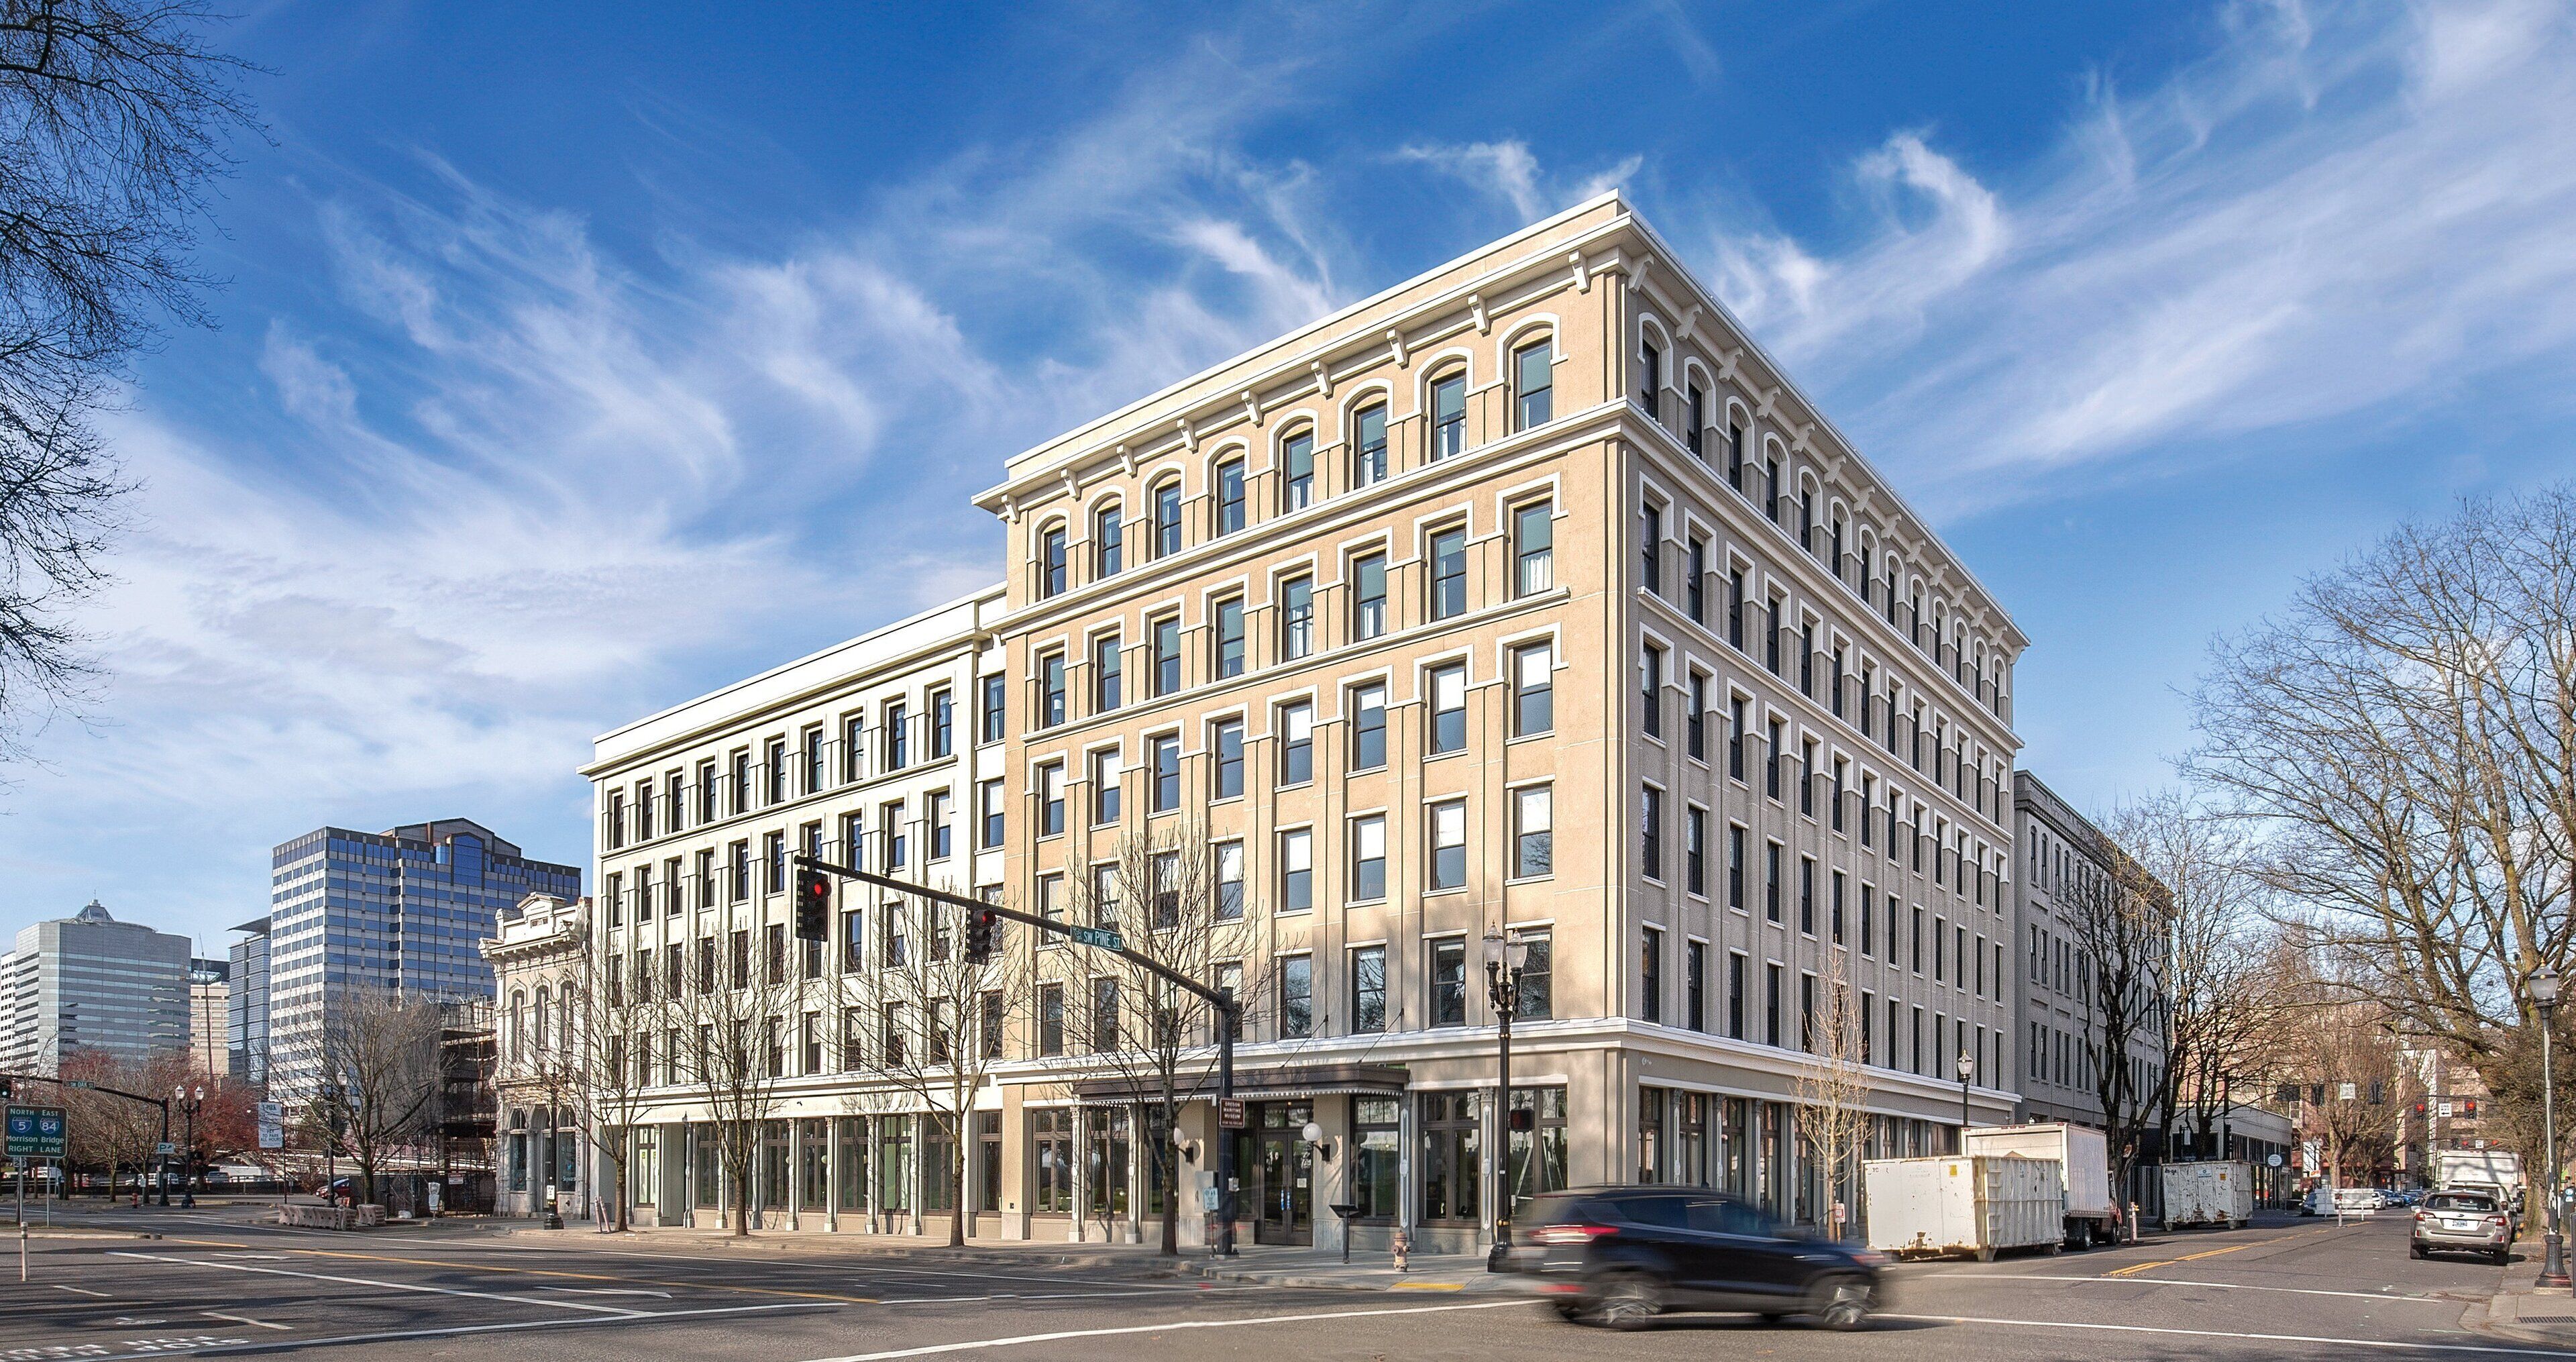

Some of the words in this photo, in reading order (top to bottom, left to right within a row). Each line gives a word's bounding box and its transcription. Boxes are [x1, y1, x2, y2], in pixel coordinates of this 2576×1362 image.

[1083, 931, 1093, 943] SW
[1095, 931, 1111, 947] PINE
[1114, 937, 1120, 949] ST
[19, 1122, 26, 1131] 5
[42, 1122, 57, 1131] 84
[41, 1137, 64, 1145] Bridge
